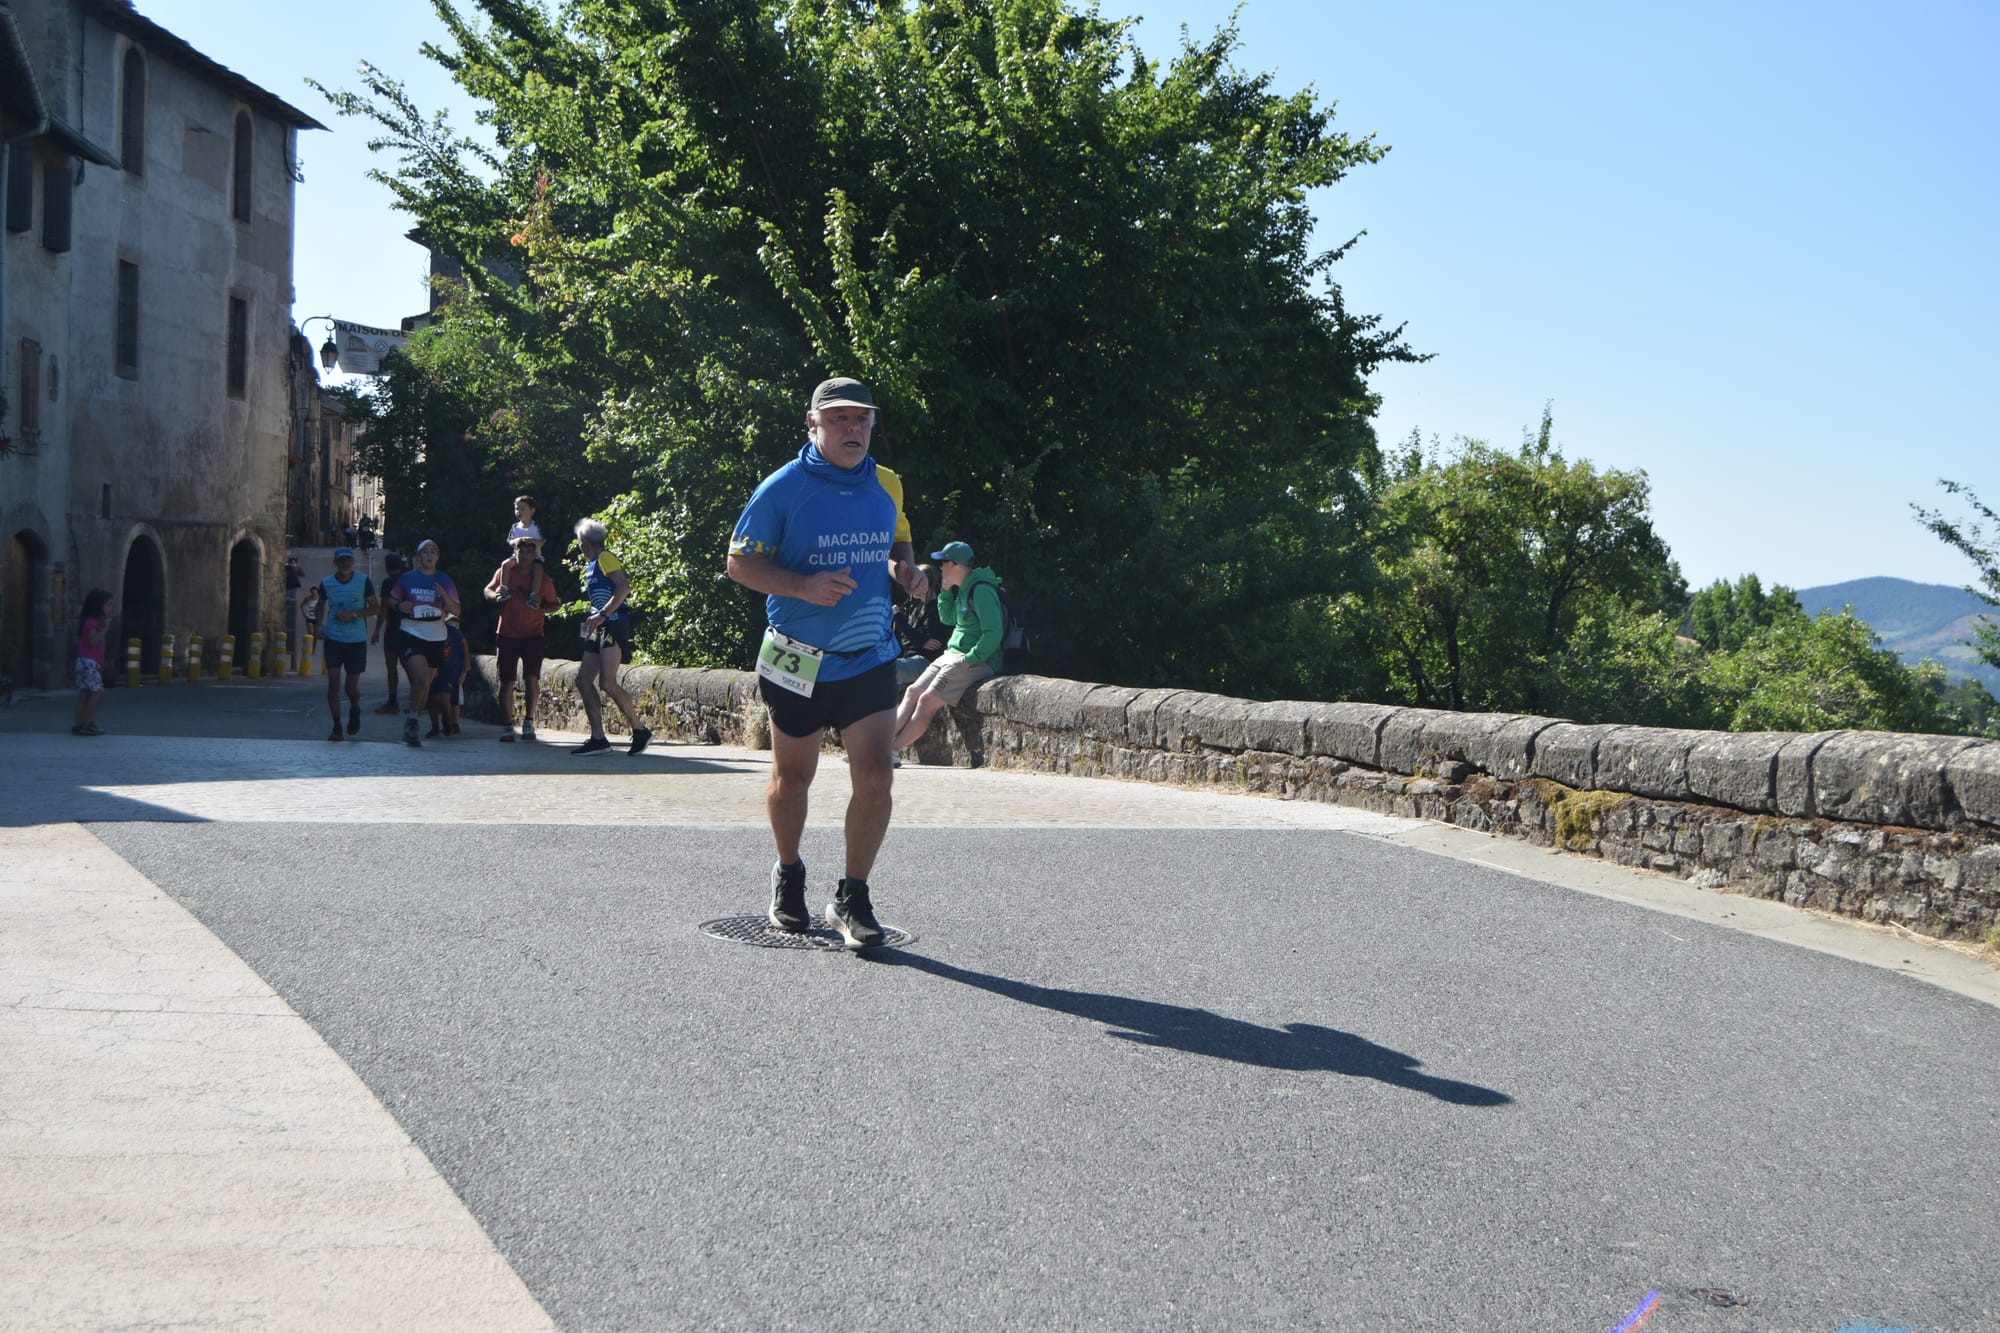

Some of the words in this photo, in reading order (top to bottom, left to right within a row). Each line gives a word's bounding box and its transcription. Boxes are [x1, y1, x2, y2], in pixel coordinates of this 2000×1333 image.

[338, 323, 388, 336] MAISON
[818, 531, 890, 548] MACADAM
[808, 551, 847, 565] CLUB
[771, 645, 801, 674] 73
